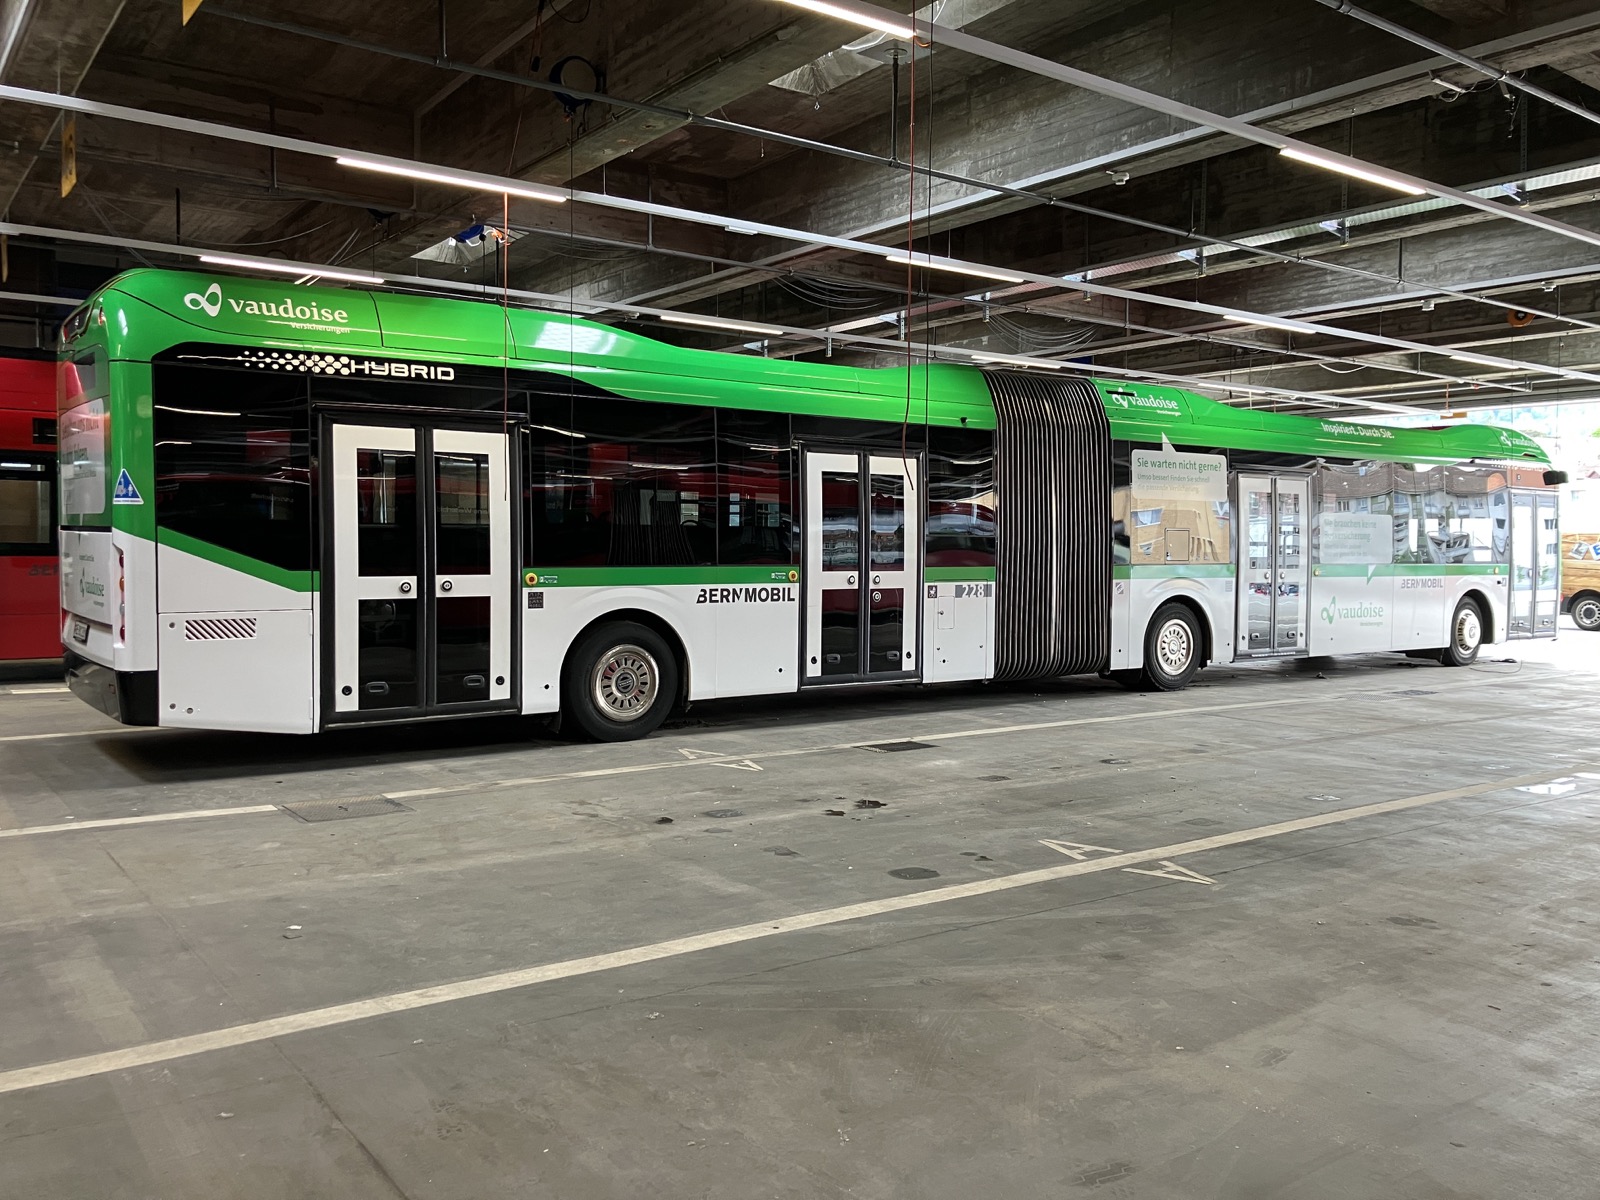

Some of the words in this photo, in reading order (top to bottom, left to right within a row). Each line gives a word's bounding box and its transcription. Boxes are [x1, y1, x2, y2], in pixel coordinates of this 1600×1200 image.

[227, 298, 349, 323] vaudoise
[351, 359, 455, 381] HYBRID
[1128, 391, 1179, 409] vaudoise
[1137, 457, 1149, 468] Sie
[1149, 459, 1177, 469] warten
[1178, 460, 1197, 471] nicht
[1198, 462, 1222, 473] gerne?
[961, 584, 985, 598] 228
[1337, 601, 1384, 619] vaudoise
